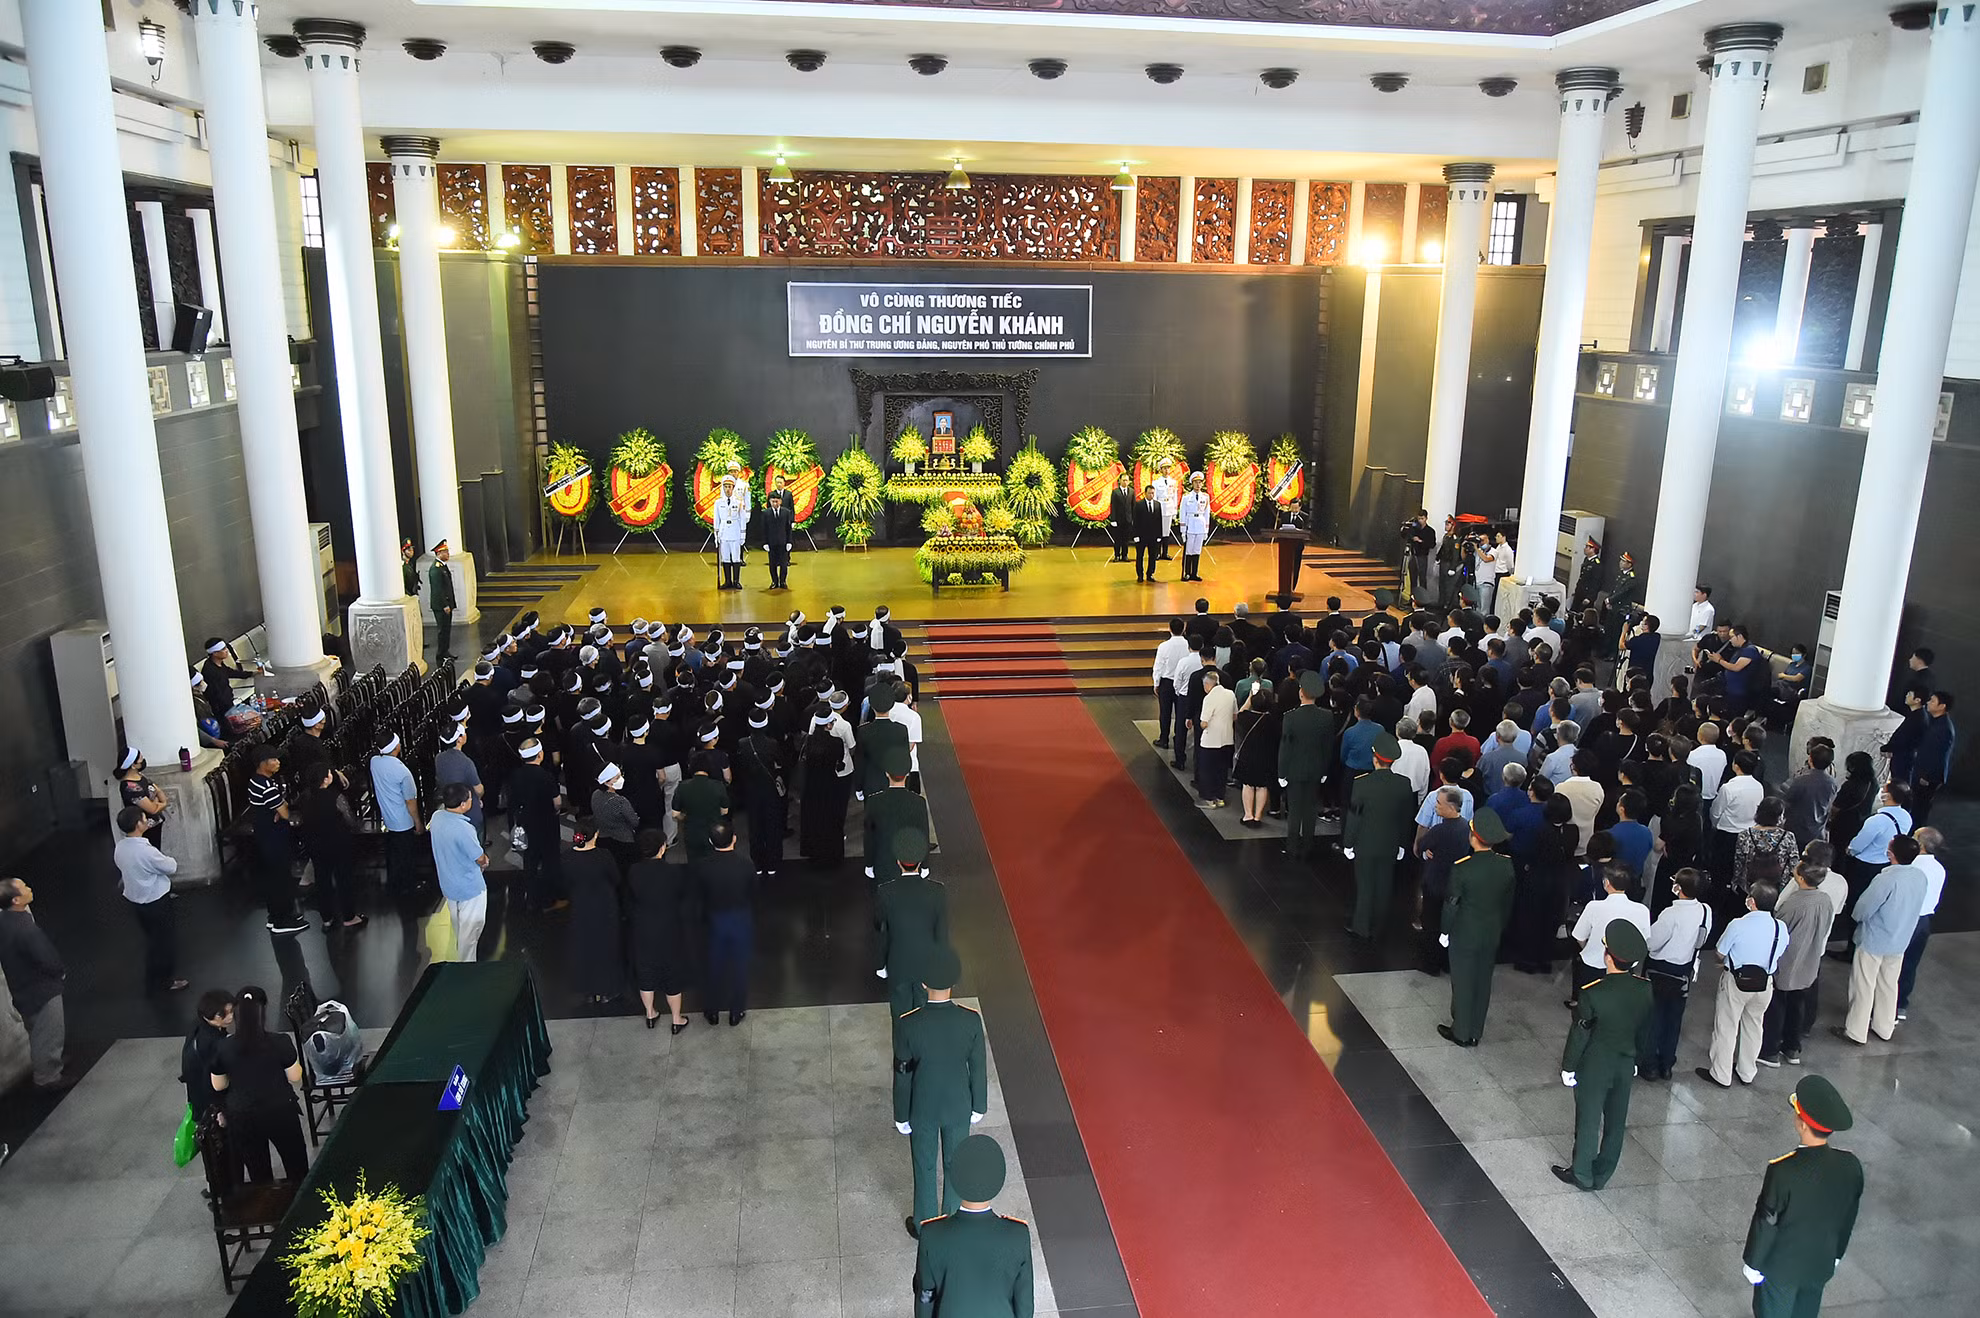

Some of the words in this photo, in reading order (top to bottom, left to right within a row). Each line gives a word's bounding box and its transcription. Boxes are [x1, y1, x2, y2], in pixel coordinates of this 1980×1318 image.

[860, 291, 879, 308] VÔ
[883, 292, 924, 308] CÙNG
[929, 293, 987, 309] THƯƠNG
[991, 292, 1023, 309] TIẾC
[819, 308, 873, 334] ĐỒNG
[878, 311, 911, 334] CHÍ
[917, 309, 994, 335] NGUYỄN
[999, 312, 1064, 335] KHÁNH
[806, 338, 837, 349] NGUYÊN
[839, 338, 848, 349] BÍ
[849, 339, 865, 349] THƯ
[866, 340, 892, 350] TRUNG
[893, 339, 915, 350] ƯƠNG
[942, 339, 973, 350] NGUYÊN
[974, 339, 990, 350] PHÓ
[991, 338, 1007, 350] THỦ
[1034, 339, 1058, 350] CHÍNH
[1059, 338, 1075, 350] PHỦ
